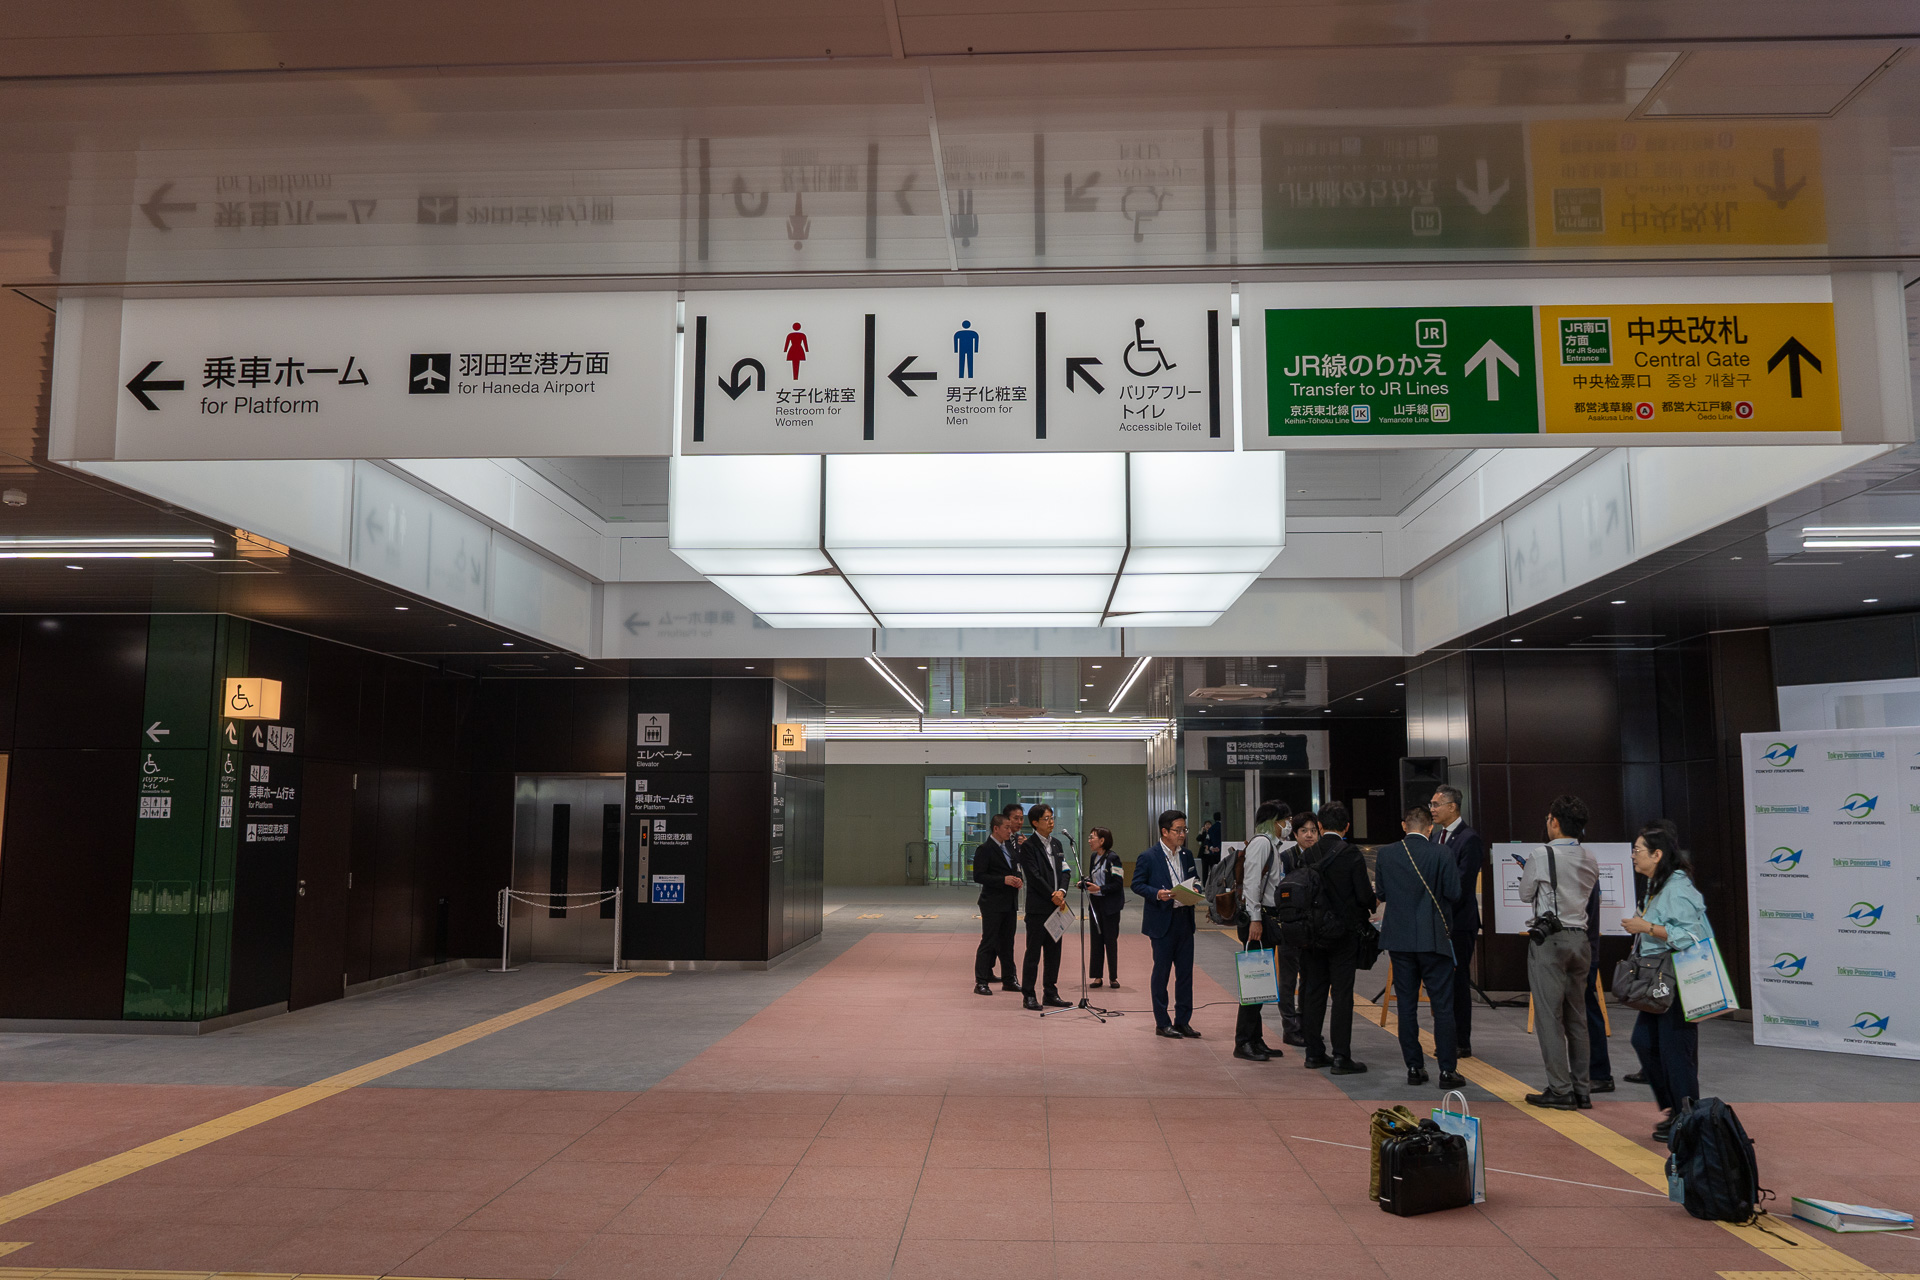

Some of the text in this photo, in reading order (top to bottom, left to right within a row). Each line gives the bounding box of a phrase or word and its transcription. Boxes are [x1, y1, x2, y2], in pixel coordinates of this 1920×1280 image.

[1565, 322, 1606, 333] JR南口
[1627, 315, 1748, 346] 中央改札
[1423, 327, 1440, 340] JR
[1565, 335, 1589, 346] 方面
[458, 352, 610, 376] 羽田空港方面
[1634, 351, 1750, 367] Central Gate
[1284, 353, 1447, 379] JR線のりかえ
[202, 356, 370, 389] 乗車ホーム
[1573, 374, 1651, 389] 中央检票口
[1666, 372, 1752, 388] 중앙 개찰구
[458, 380, 596, 395] for Haneda Airport
[1118, 385, 1202, 400] バリアフリー
[1290, 381, 1449, 397] Transfer to JR Lines
[775, 388, 856, 404] 女子化粧室
[946, 386, 1027, 402] 男子化粧室
[200, 396, 319, 414] for Platform
[946, 405, 1013, 415] Restroom for
[1290, 404, 1350, 417] 京浜東北線
[1393, 404, 1429, 416] 山手線
[1574, 402, 1633, 413] 都営浅草線
[1662, 401, 1733, 412] 都営大江戸線
[775, 406, 842, 416] Restroom for
[1122, 403, 1165, 419] トイレ
[1355, 409, 1366, 419] JK
[1434, 408, 1446, 418] JY
[775, 418, 814, 427] Women
[946, 416, 968, 425] Men
[1414, 416, 1430, 424] Line
[1118, 422, 1202, 432] Accessible Toilet
[637, 751, 692, 759] エレベーター
[249, 785, 295, 800] 乗車ホーム行き
[635, 794, 694, 804] 乗車ホーム行き
[1755, 805, 1770, 813] Tokyo
[258, 824, 289, 834] 羽田空港方面
[1833, 858, 1848, 866] Tokyo
[1878, 859, 1891, 867] Line
[1759, 909, 1774, 918] Tokyo
[1803, 911, 1814, 919] Line
[1837, 967, 1853, 975] Tokyo
[1884, 970, 1896, 978] Line
[1763, 1015, 1779, 1024] Tokyo
[1808, 1019, 1819, 1027] Line
